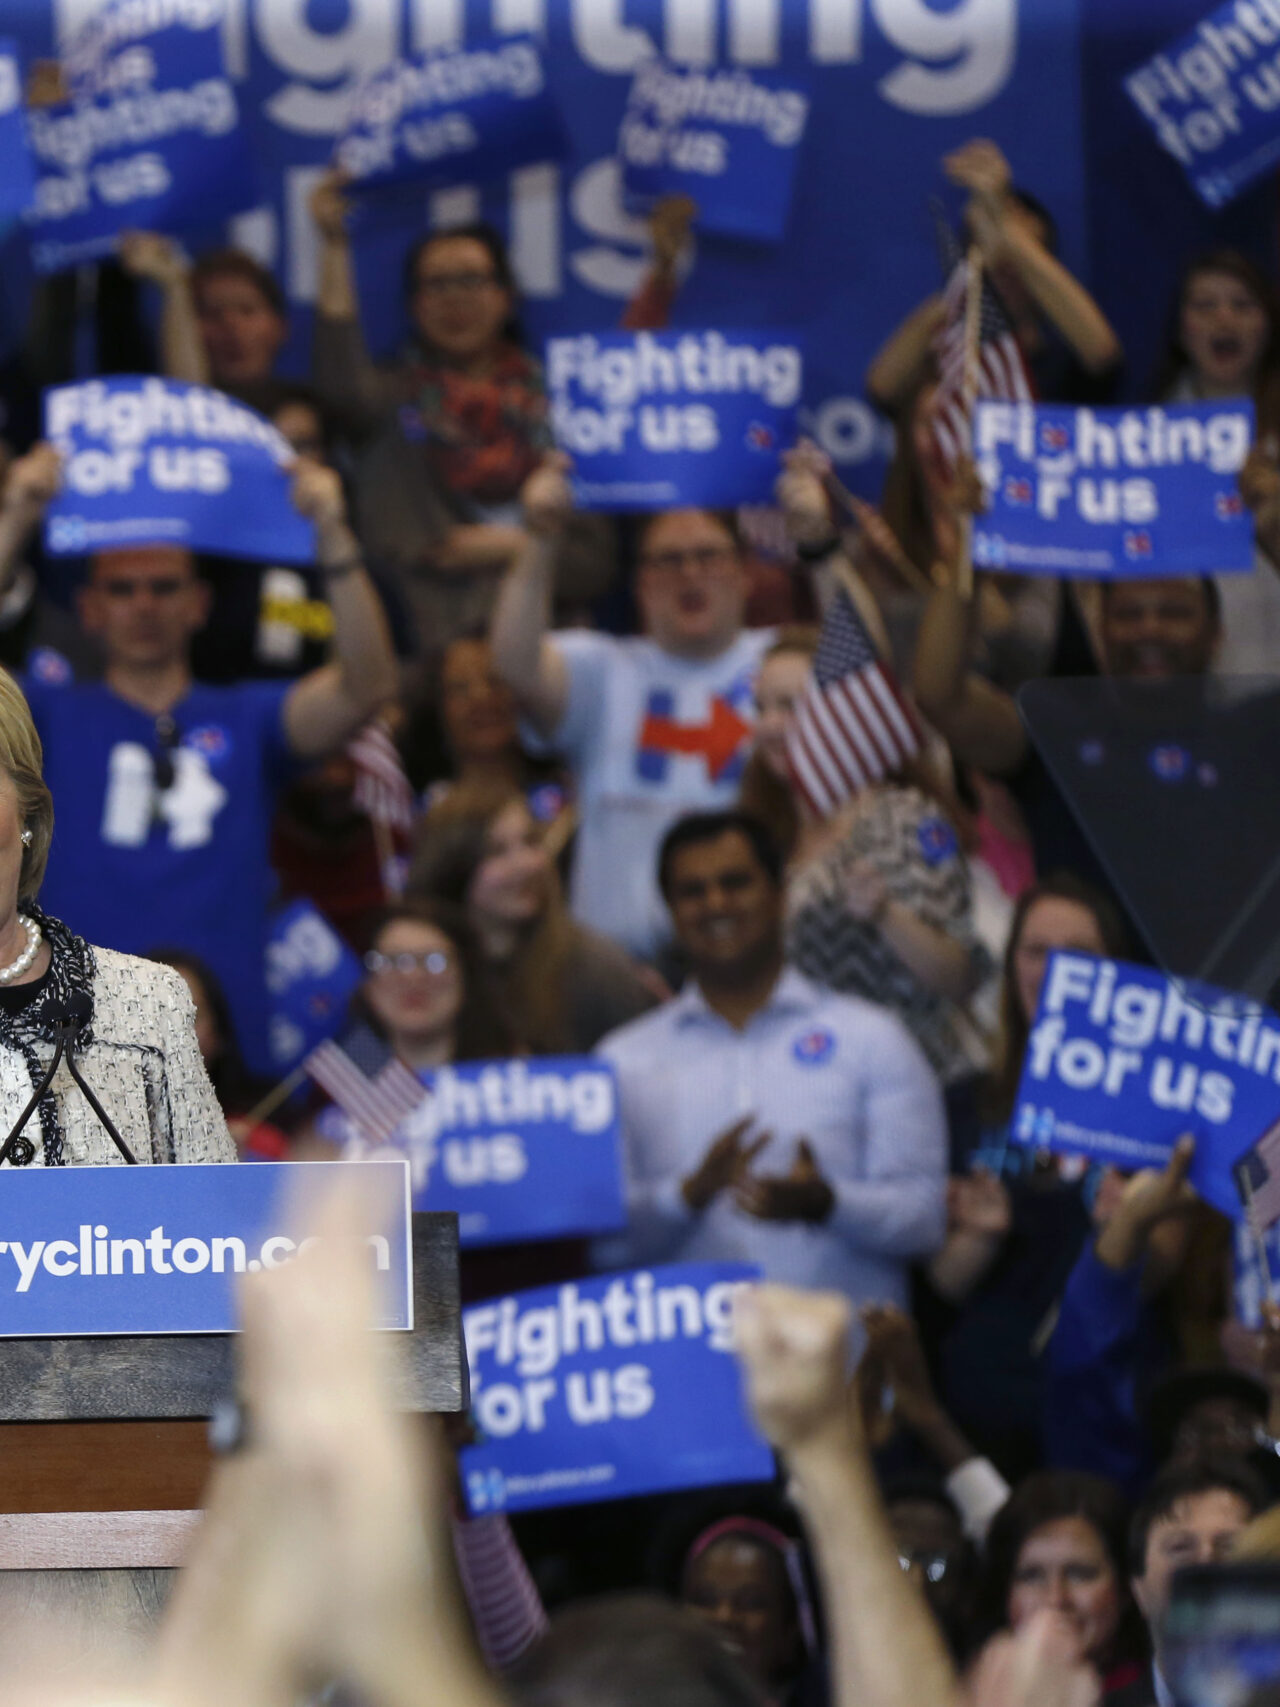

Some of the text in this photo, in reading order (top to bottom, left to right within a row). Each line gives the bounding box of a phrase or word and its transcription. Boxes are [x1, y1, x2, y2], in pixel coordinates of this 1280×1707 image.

[1123, 0, 1280, 118] Fight
[92, 151, 170, 200] us
[546, 330, 803, 408] Fighting
[639, 402, 720, 453] us
[65, 444, 233, 497] or us
[977, 450, 1161, 524] fr us
[1043, 953, 1280, 1090] Fightin
[1030, 1014, 1236, 1126] for us
[443, 1131, 528, 1187] us
[462, 1271, 740, 1377] Fighting
[565, 1362, 656, 1426] us
